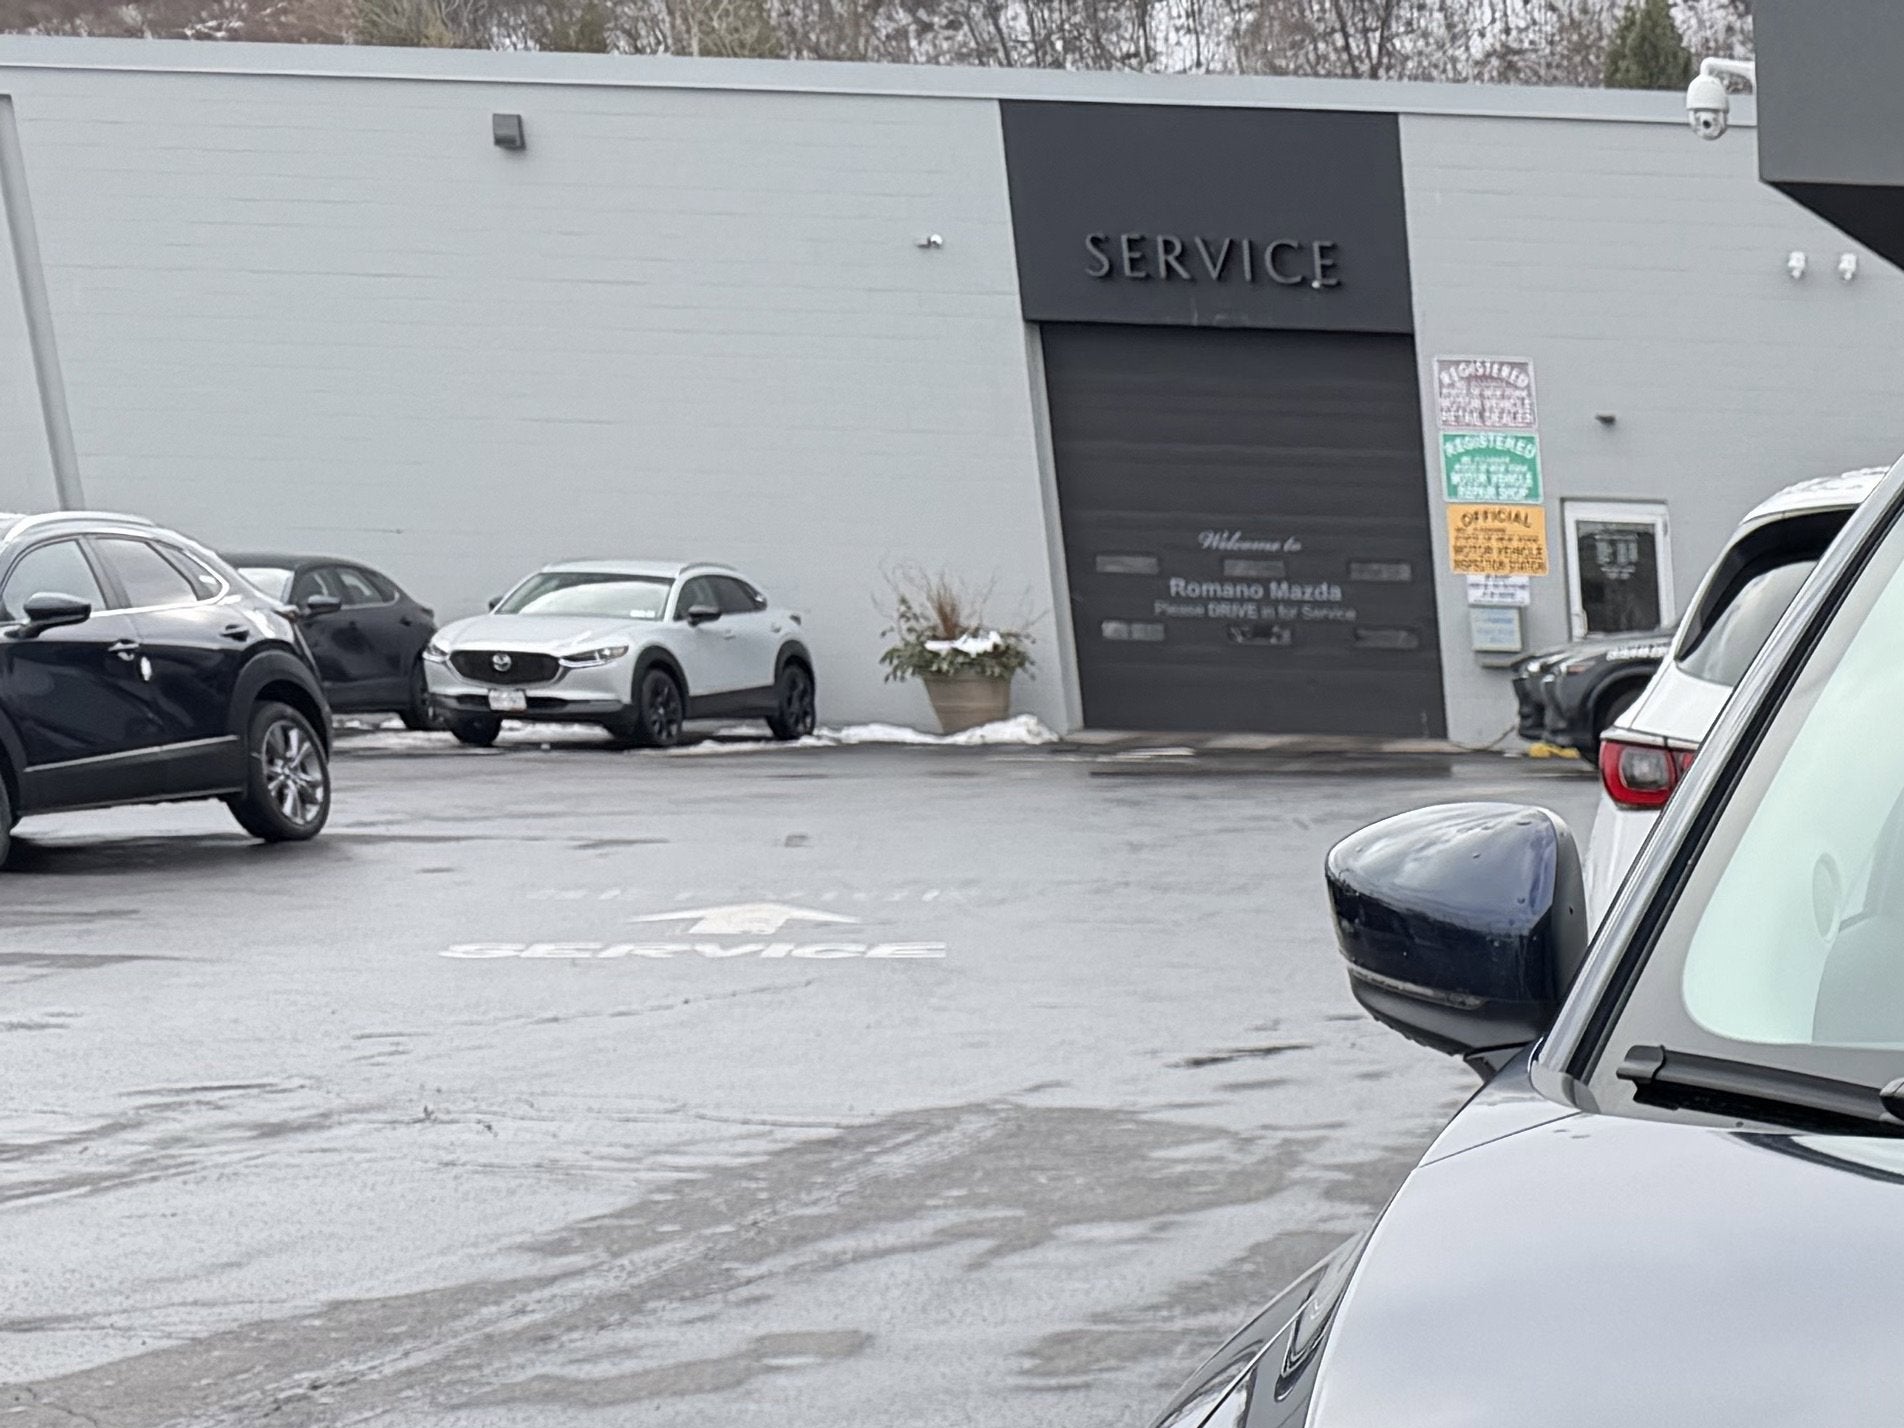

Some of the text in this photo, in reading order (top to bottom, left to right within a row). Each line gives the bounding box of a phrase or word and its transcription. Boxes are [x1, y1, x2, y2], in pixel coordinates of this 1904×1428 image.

[1085, 233, 1340, 286] SERVICE
[1461, 509, 1532, 528] OFFICIAL
[1198, 530, 1302, 552] Welcome to
[1169, 577, 1343, 601] Romano Mazda
[1207, 601, 1259, 620] DRIVE
[1301, 605, 1357, 622] Service
[438, 942, 946, 959] SERVICE
